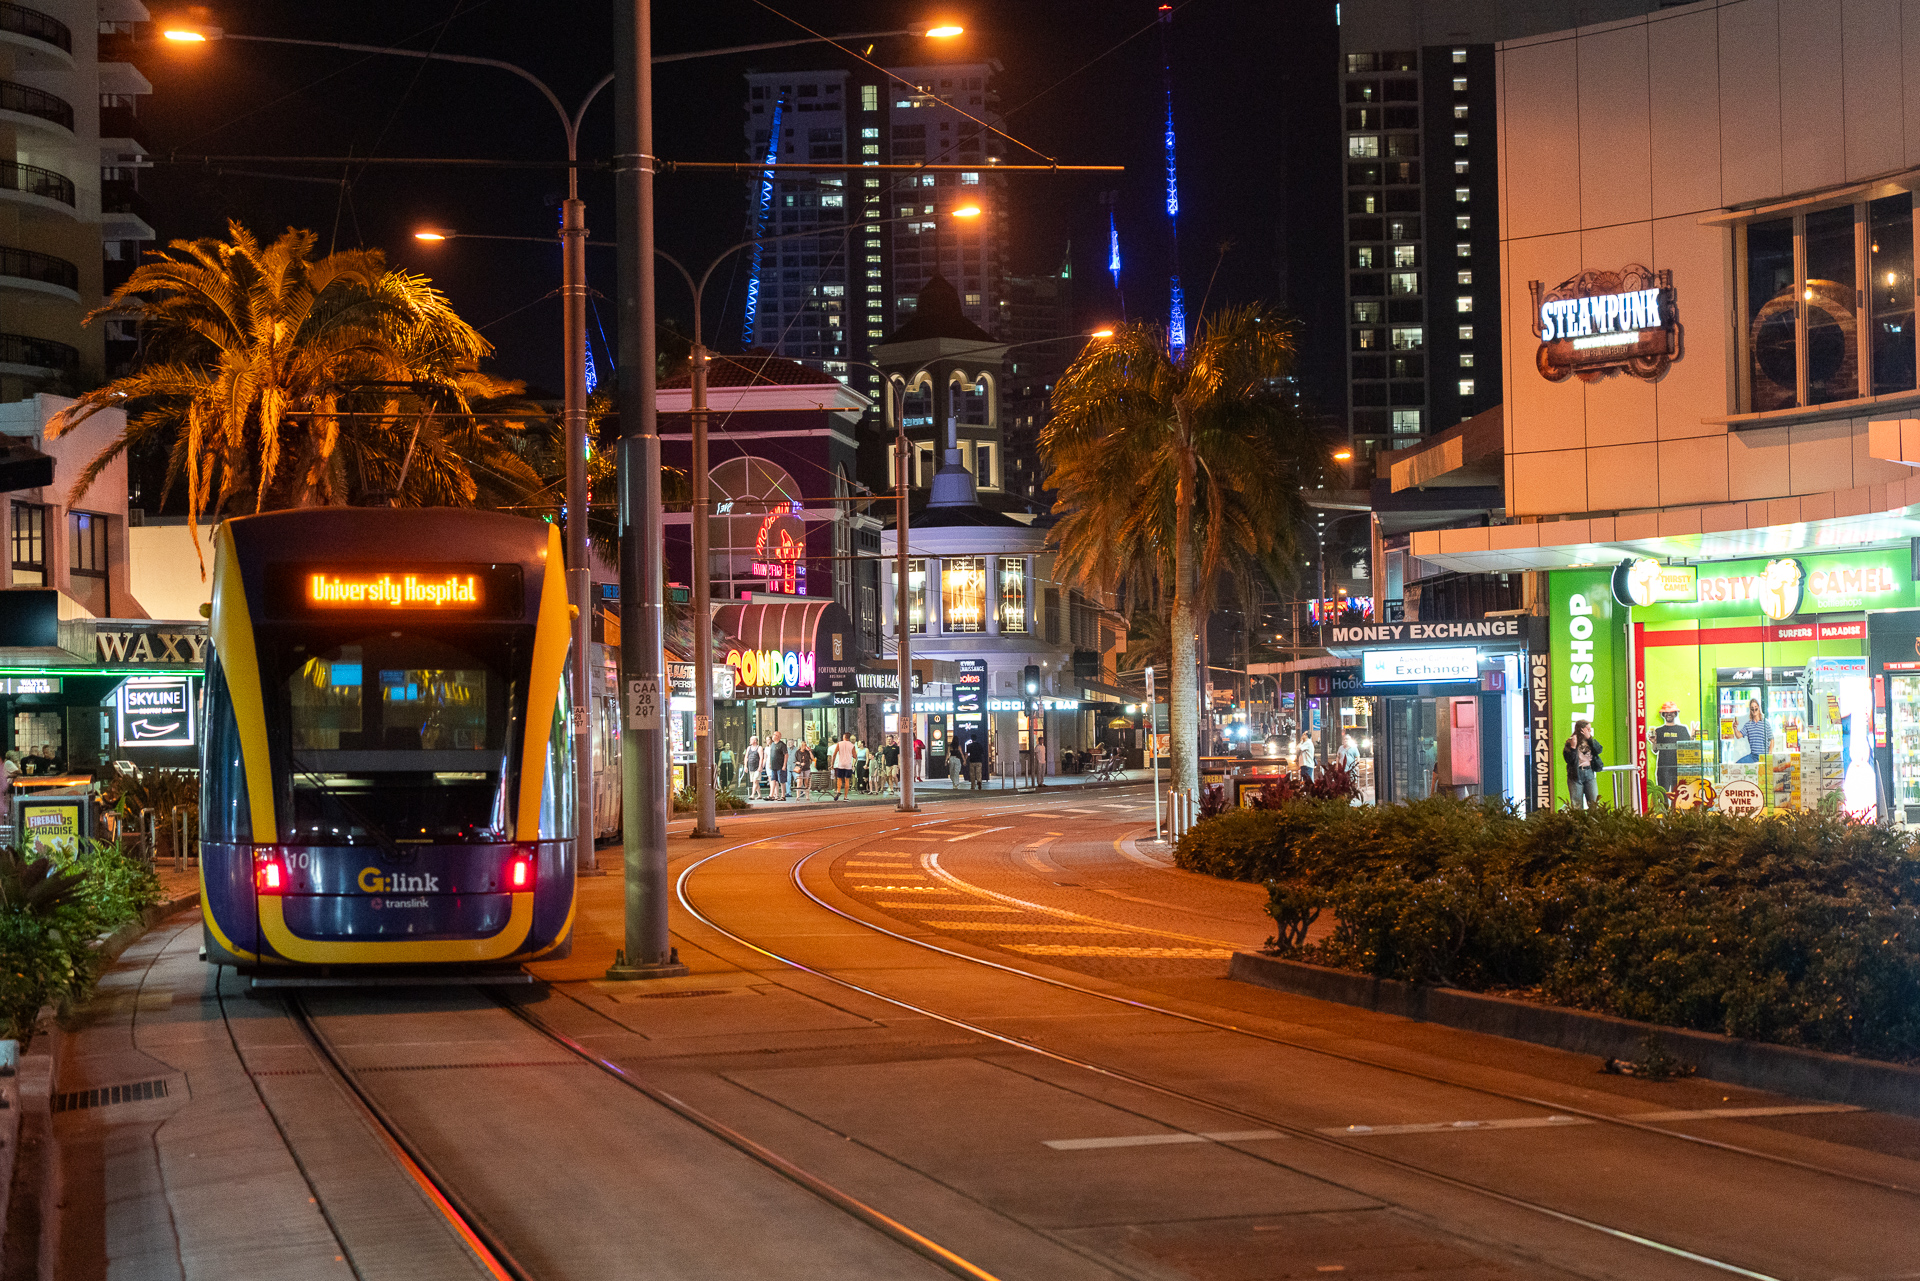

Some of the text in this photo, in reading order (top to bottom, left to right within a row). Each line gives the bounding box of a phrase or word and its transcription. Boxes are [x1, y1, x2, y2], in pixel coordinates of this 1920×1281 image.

[1541, 288, 1661, 341] STEAMPUNK
[1661, 575, 1692, 584] THIRSTY
[1808, 567, 1891, 597] CAMEL
[312, 575, 477, 606] University Hospital
[1664, 584, 1689, 592] CAMEL
[1817, 598, 1863, 609] bottleshops
[1332, 621, 1519, 642] MONEY EXCHANGE
[1778, 625, 1861, 638] SURFERS PARADISE
[96, 632, 208, 663] WAXY
[726, 649, 816, 687] CONDOM
[818, 666, 856, 674] FORTUNE ABALONE
[1395, 664, 1470, 676] Exchange
[633, 683, 657, 693] CAA
[1318, 676, 1373, 693] LJ Hook
[1491, 674, 1502, 688] LJ
[129, 691, 181, 706] SKYLINE
[746, 687, 790, 696] KINGDOM
[638, 694, 652, 704] 28
[1055, 700, 1079, 710] BAR
[635, 705, 655, 718] 287
[1531, 654, 1551, 808] MONEY TRANSFER
[1636, 680, 1647, 779] OPEN 7 DAYS
[1725, 790, 1759, 798] SPIRITS,
[29, 814, 63, 828] FIREBALL
[290, 853, 309, 869] 10
[357, 866, 439, 893] G:link
[385, 898, 429, 908] translink
